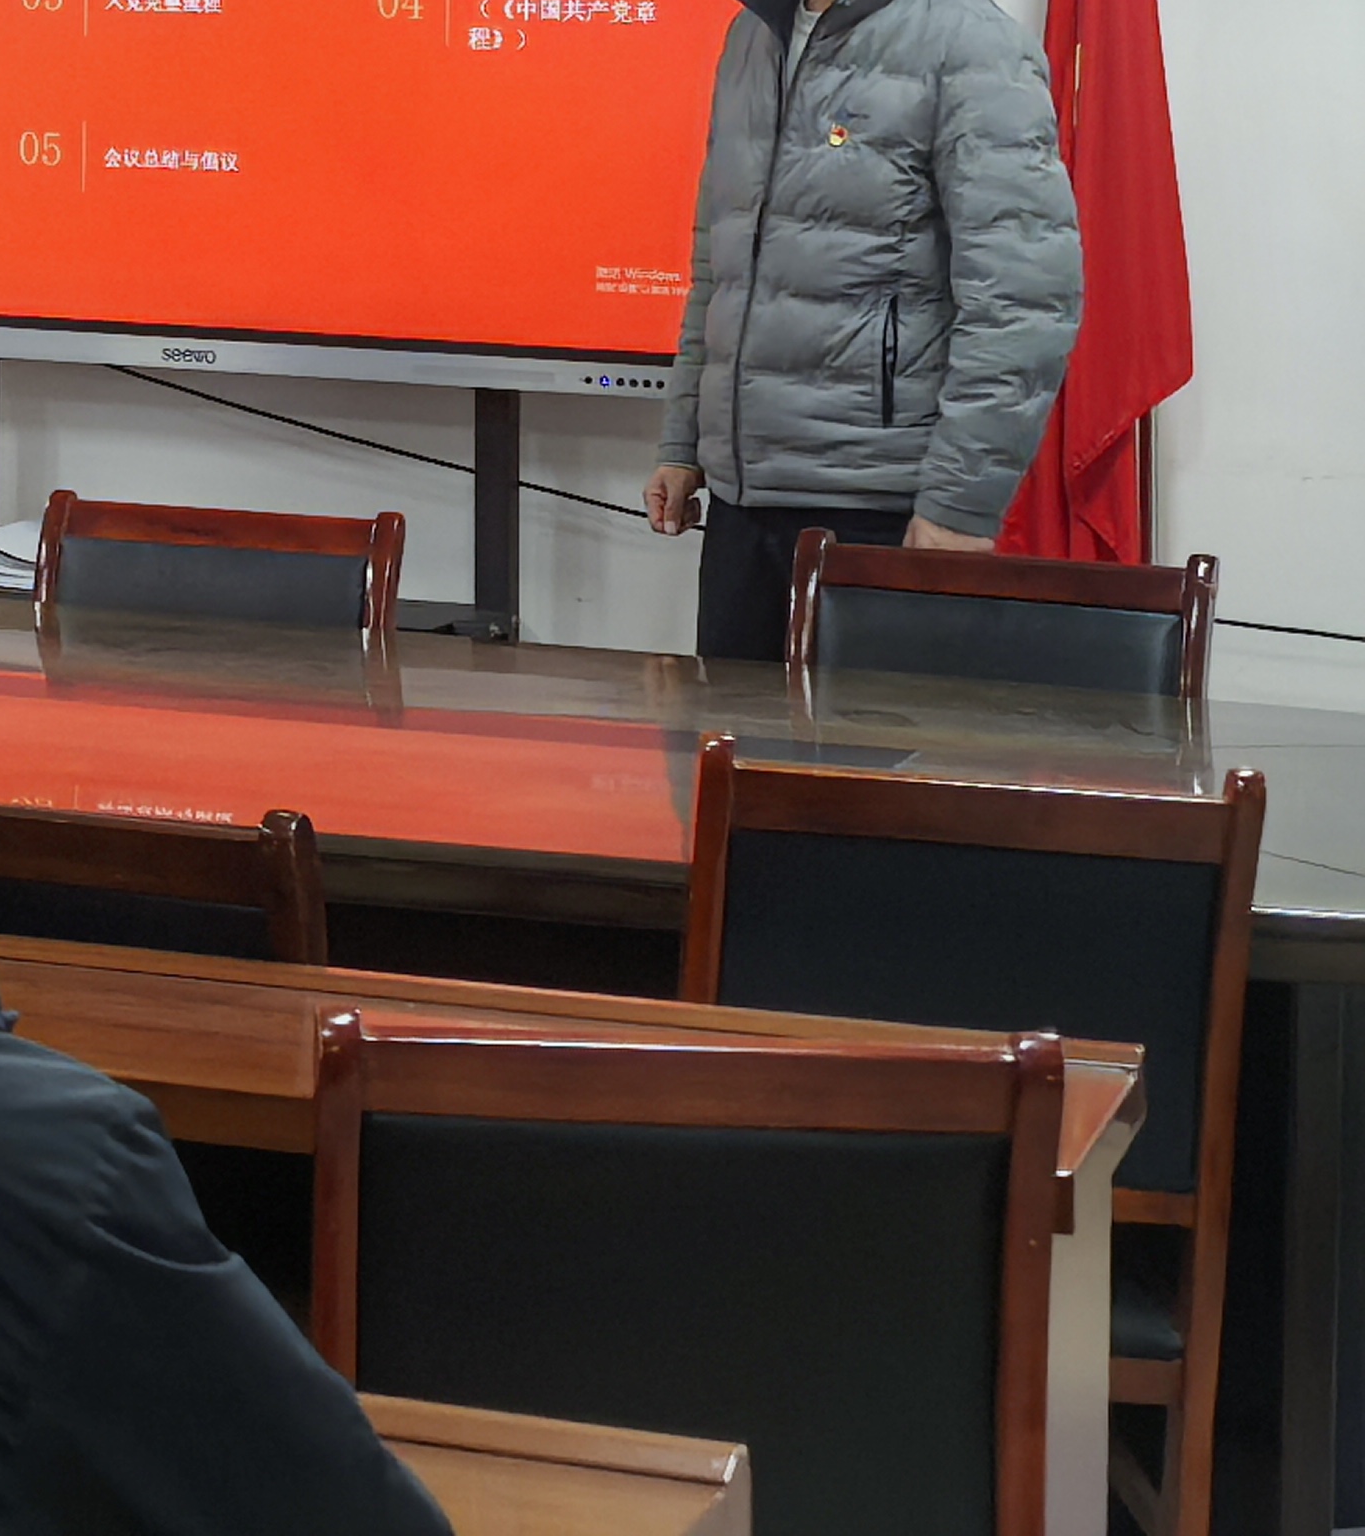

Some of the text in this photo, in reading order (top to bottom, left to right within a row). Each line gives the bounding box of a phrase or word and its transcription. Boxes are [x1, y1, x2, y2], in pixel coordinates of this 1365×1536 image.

[19, 130, 62, 166] 05
[104, 147, 240, 172] 会议总结与倡议
[162, 347, 217, 365] seewo
